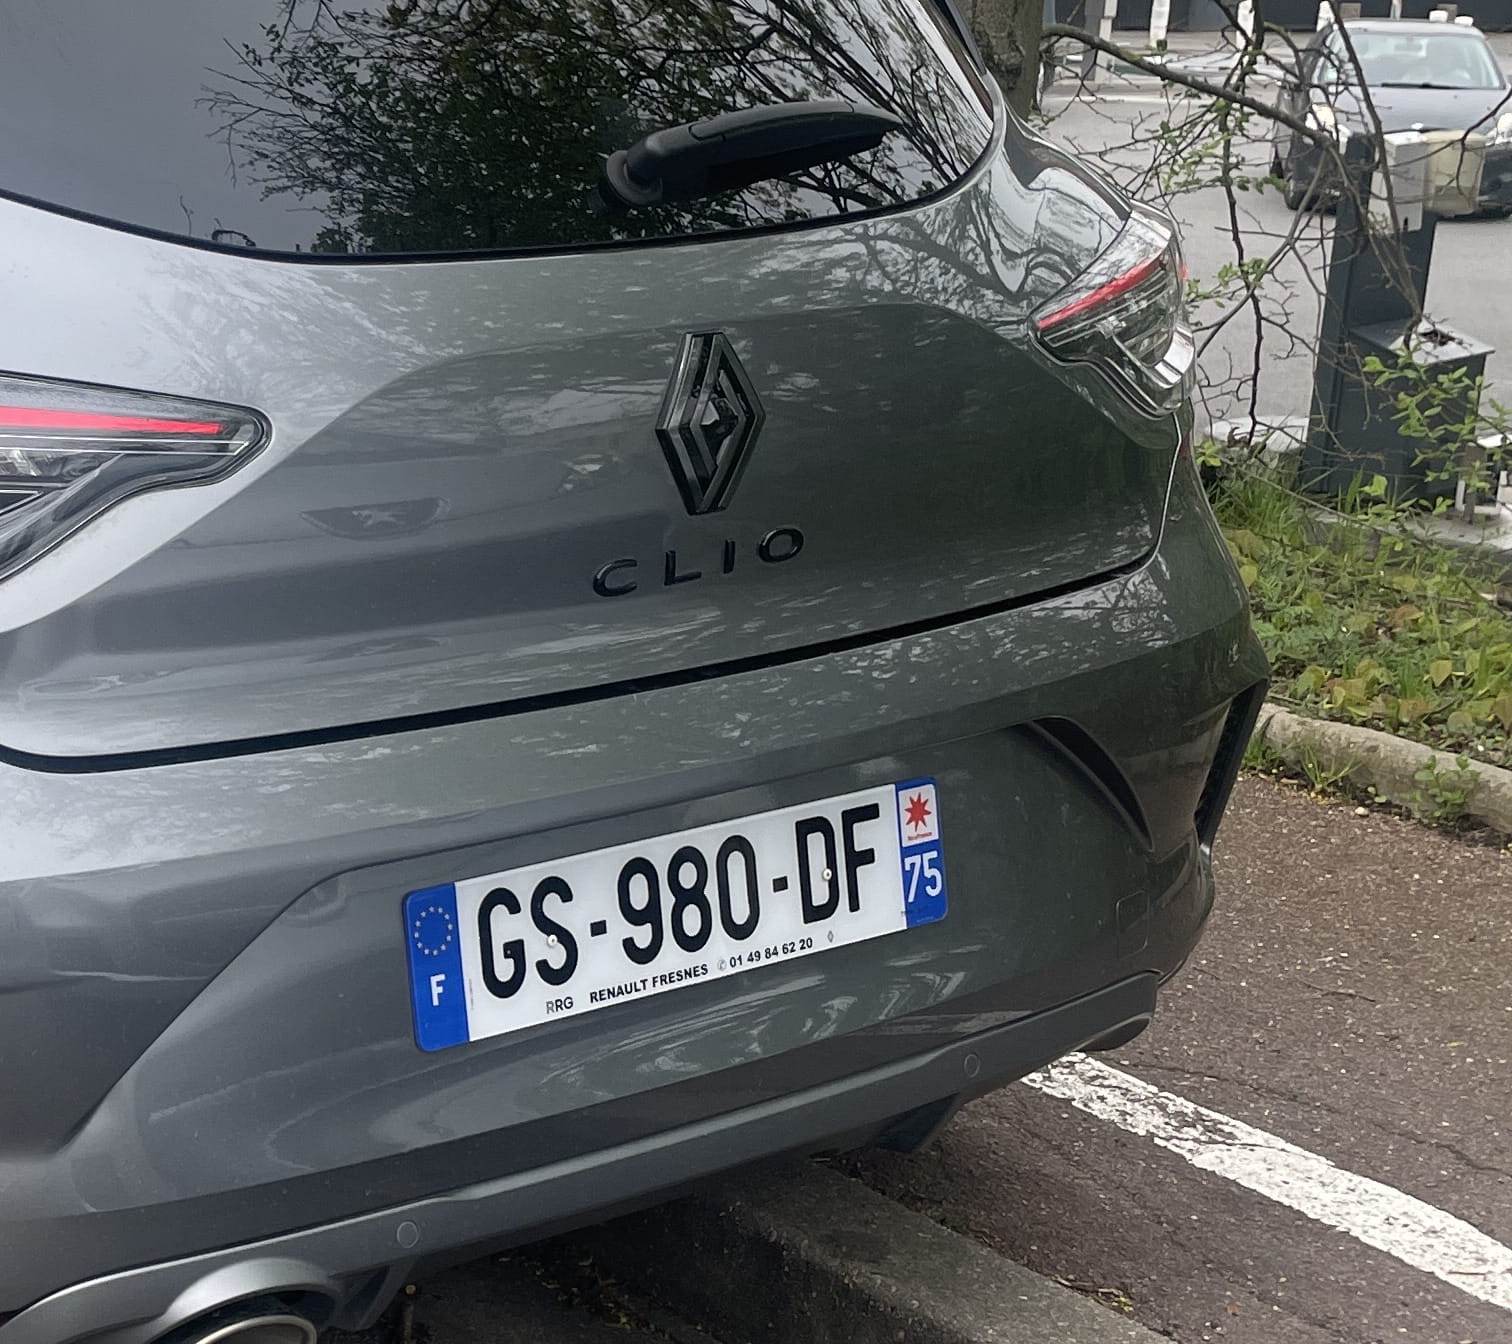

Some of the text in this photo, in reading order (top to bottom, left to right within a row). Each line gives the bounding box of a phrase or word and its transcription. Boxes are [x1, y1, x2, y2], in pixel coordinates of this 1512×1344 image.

[592, 527, 805, 597] CLIO
[477, 802, 881, 999] GS-980-DF
[904, 850, 942, 903] 75
[429, 973, 446, 1007] F
[589, 978, 649, 1004] RENAULT
[652, 963, 709, 989] FRESNES
[729, 955, 743, 968] 01
[747, 950, 762, 963] 49
[765, 945, 779, 959] 84
[782, 941, 796, 955] 62
[799, 937, 814, 951] 20
